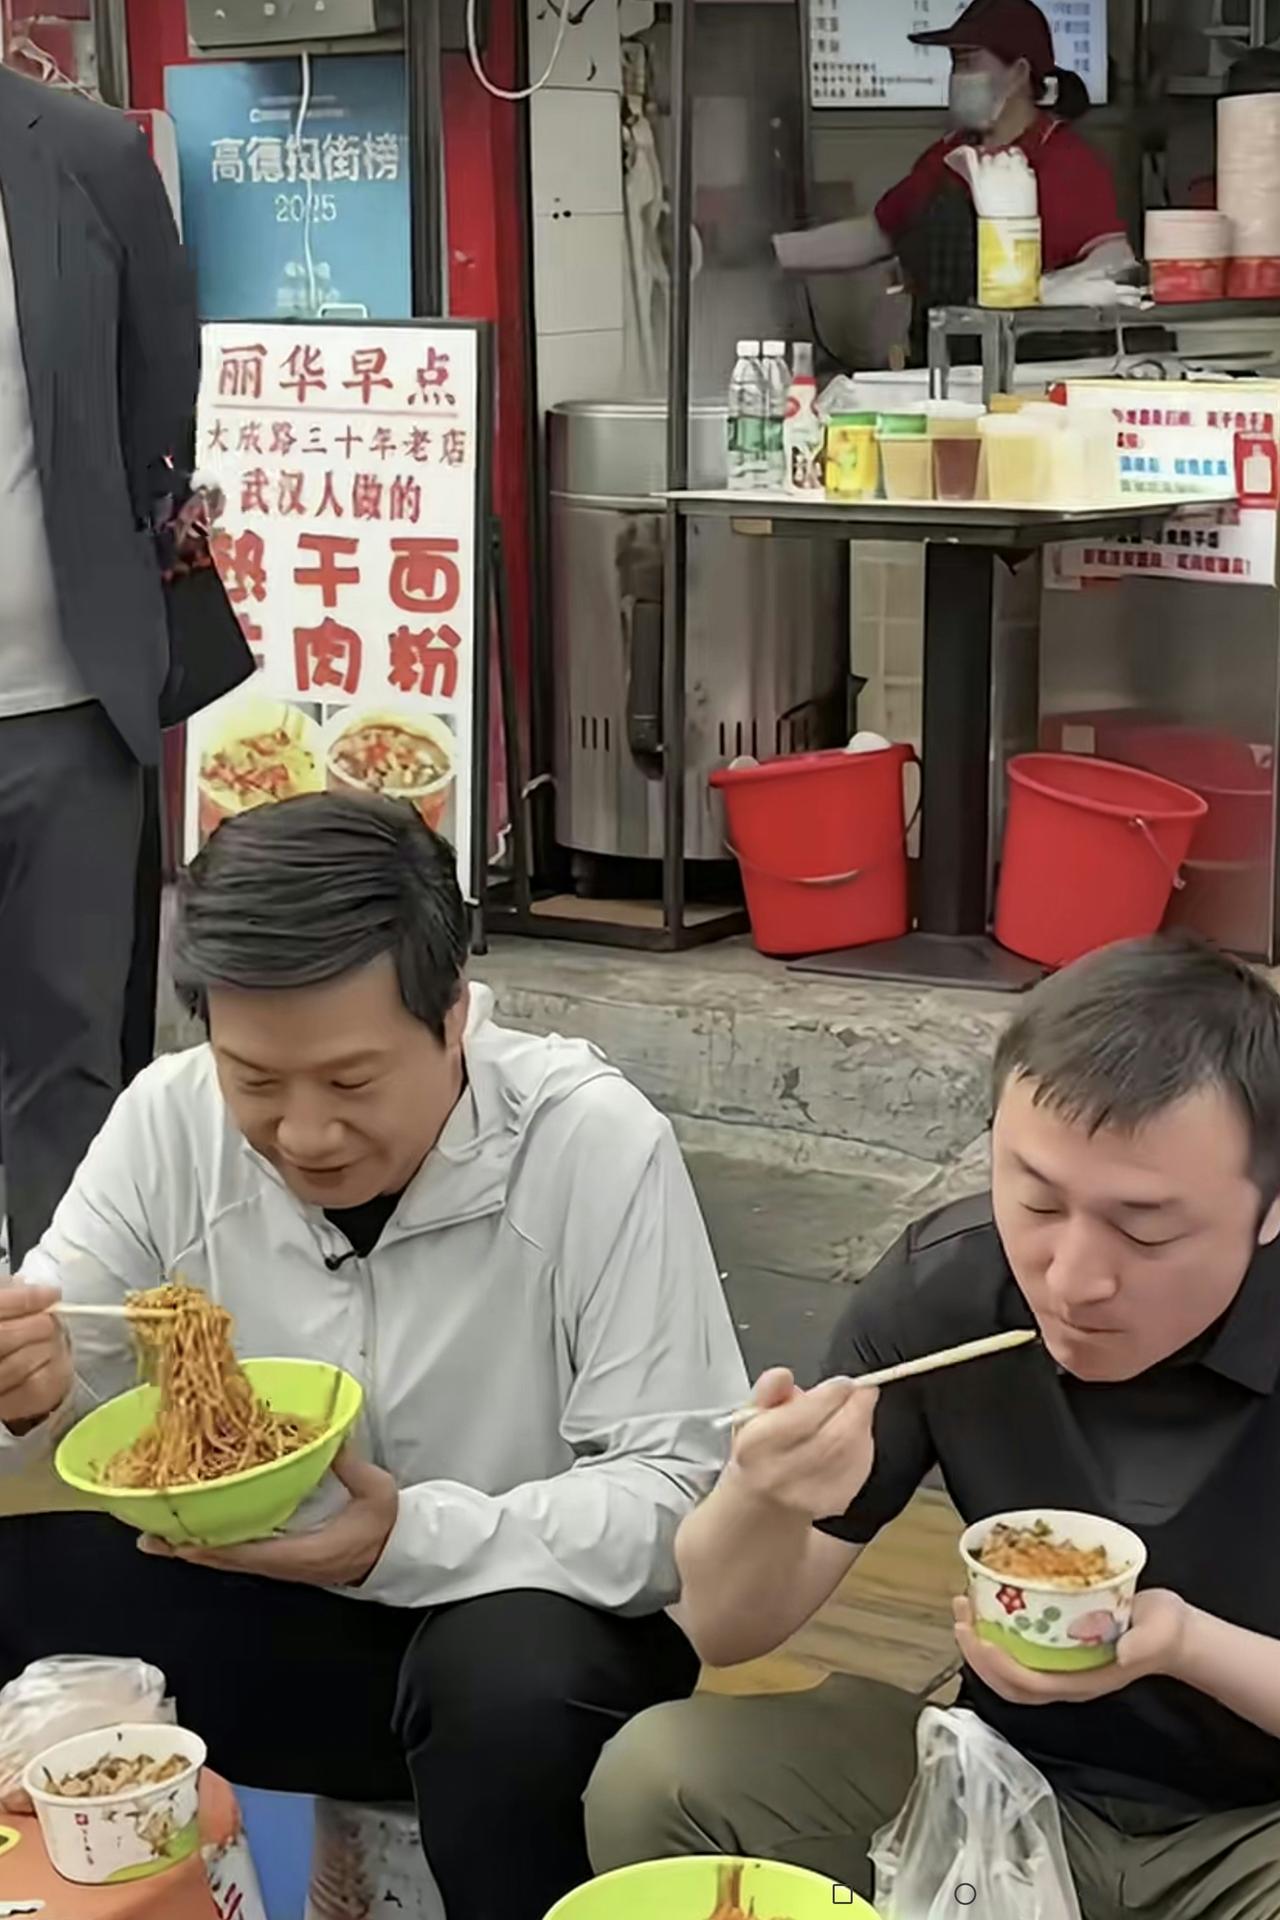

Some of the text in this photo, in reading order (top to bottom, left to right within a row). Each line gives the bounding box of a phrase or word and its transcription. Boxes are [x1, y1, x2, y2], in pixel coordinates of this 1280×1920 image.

[218, 343, 456, 405] 丽华早点
[240, 467, 422, 523] 武汉人做的
[238, 615, 462, 698] 肉粉
